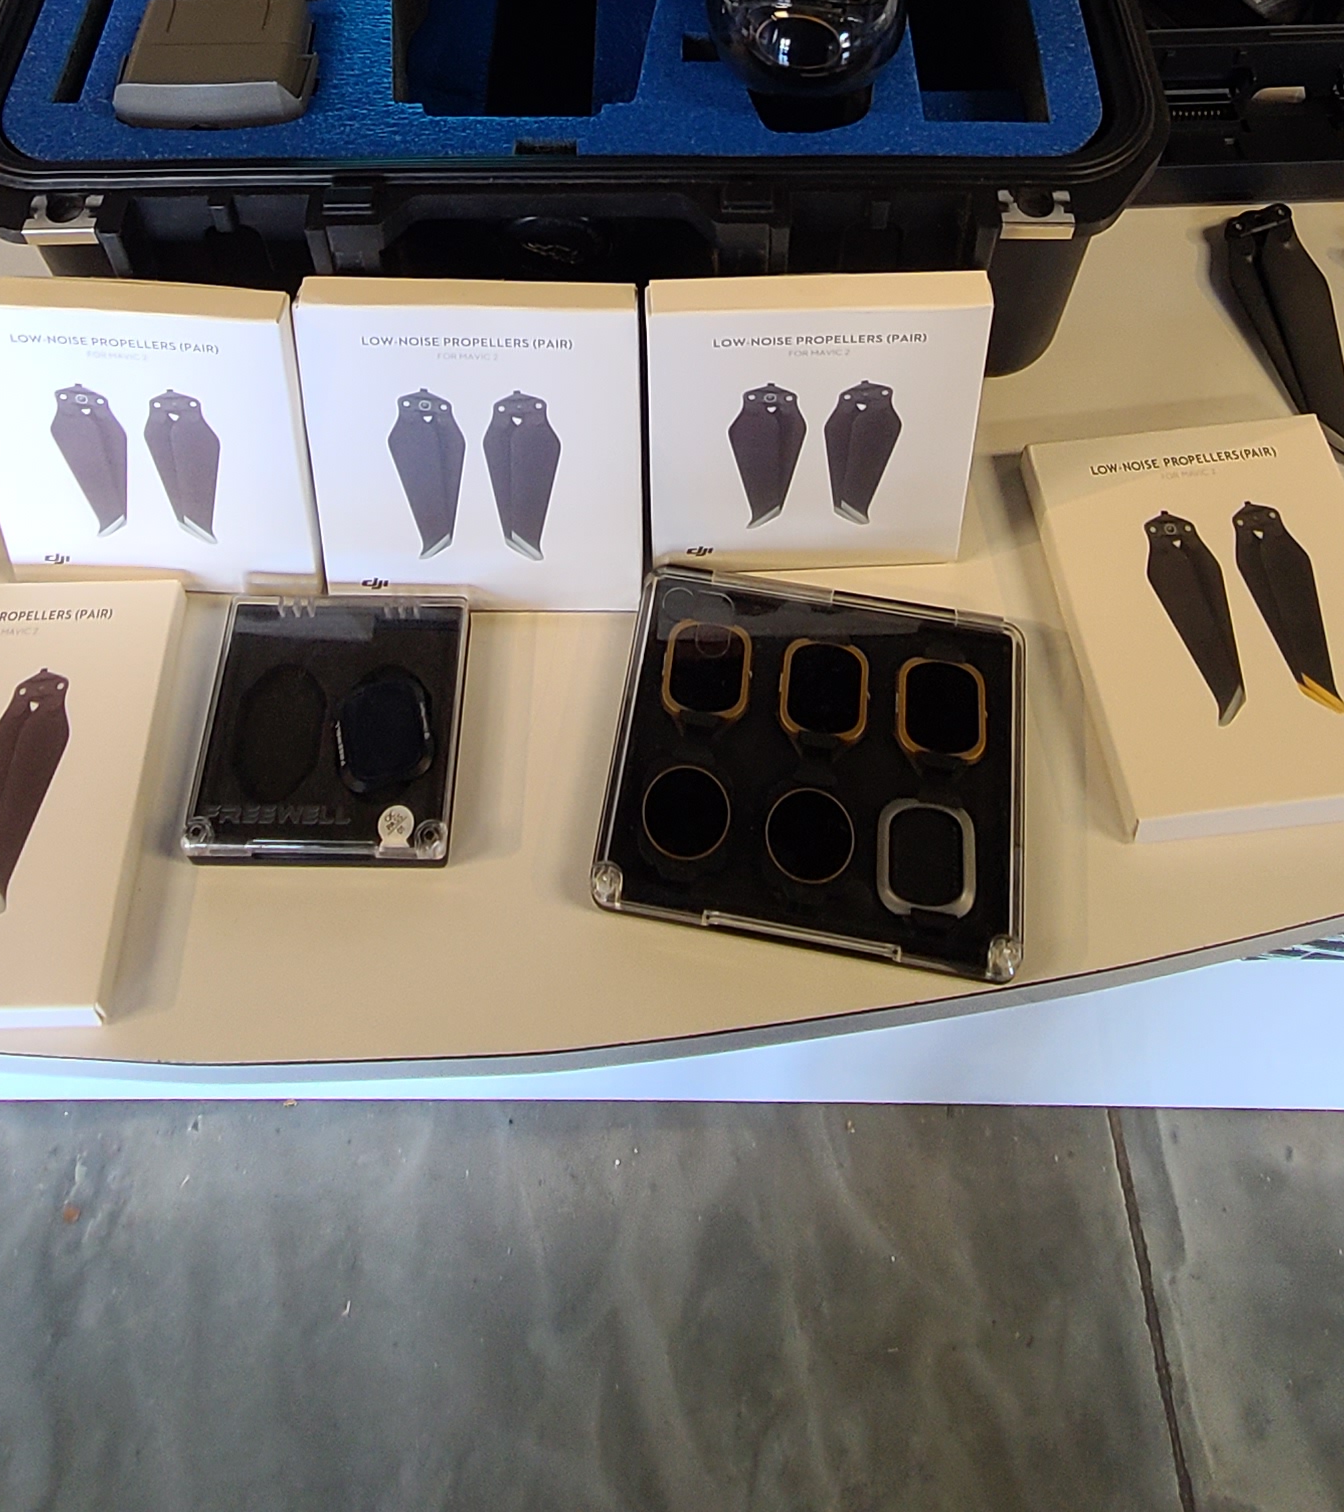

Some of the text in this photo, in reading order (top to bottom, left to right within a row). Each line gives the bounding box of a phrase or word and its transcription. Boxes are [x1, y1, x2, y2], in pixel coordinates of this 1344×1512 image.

[10, 333, 219, 355] LOW-NOISE PROPELLERS (PAIR)
[361, 336, 574, 350] LOW-NOISE PROPELLERS (PAIR)
[712, 332, 928, 348] LOW-NOISE PROPELLERS (PAIR)
[1090, 458, 1160, 476] LOW-NOISE
[74, 608, 113, 621] (PAIR)
